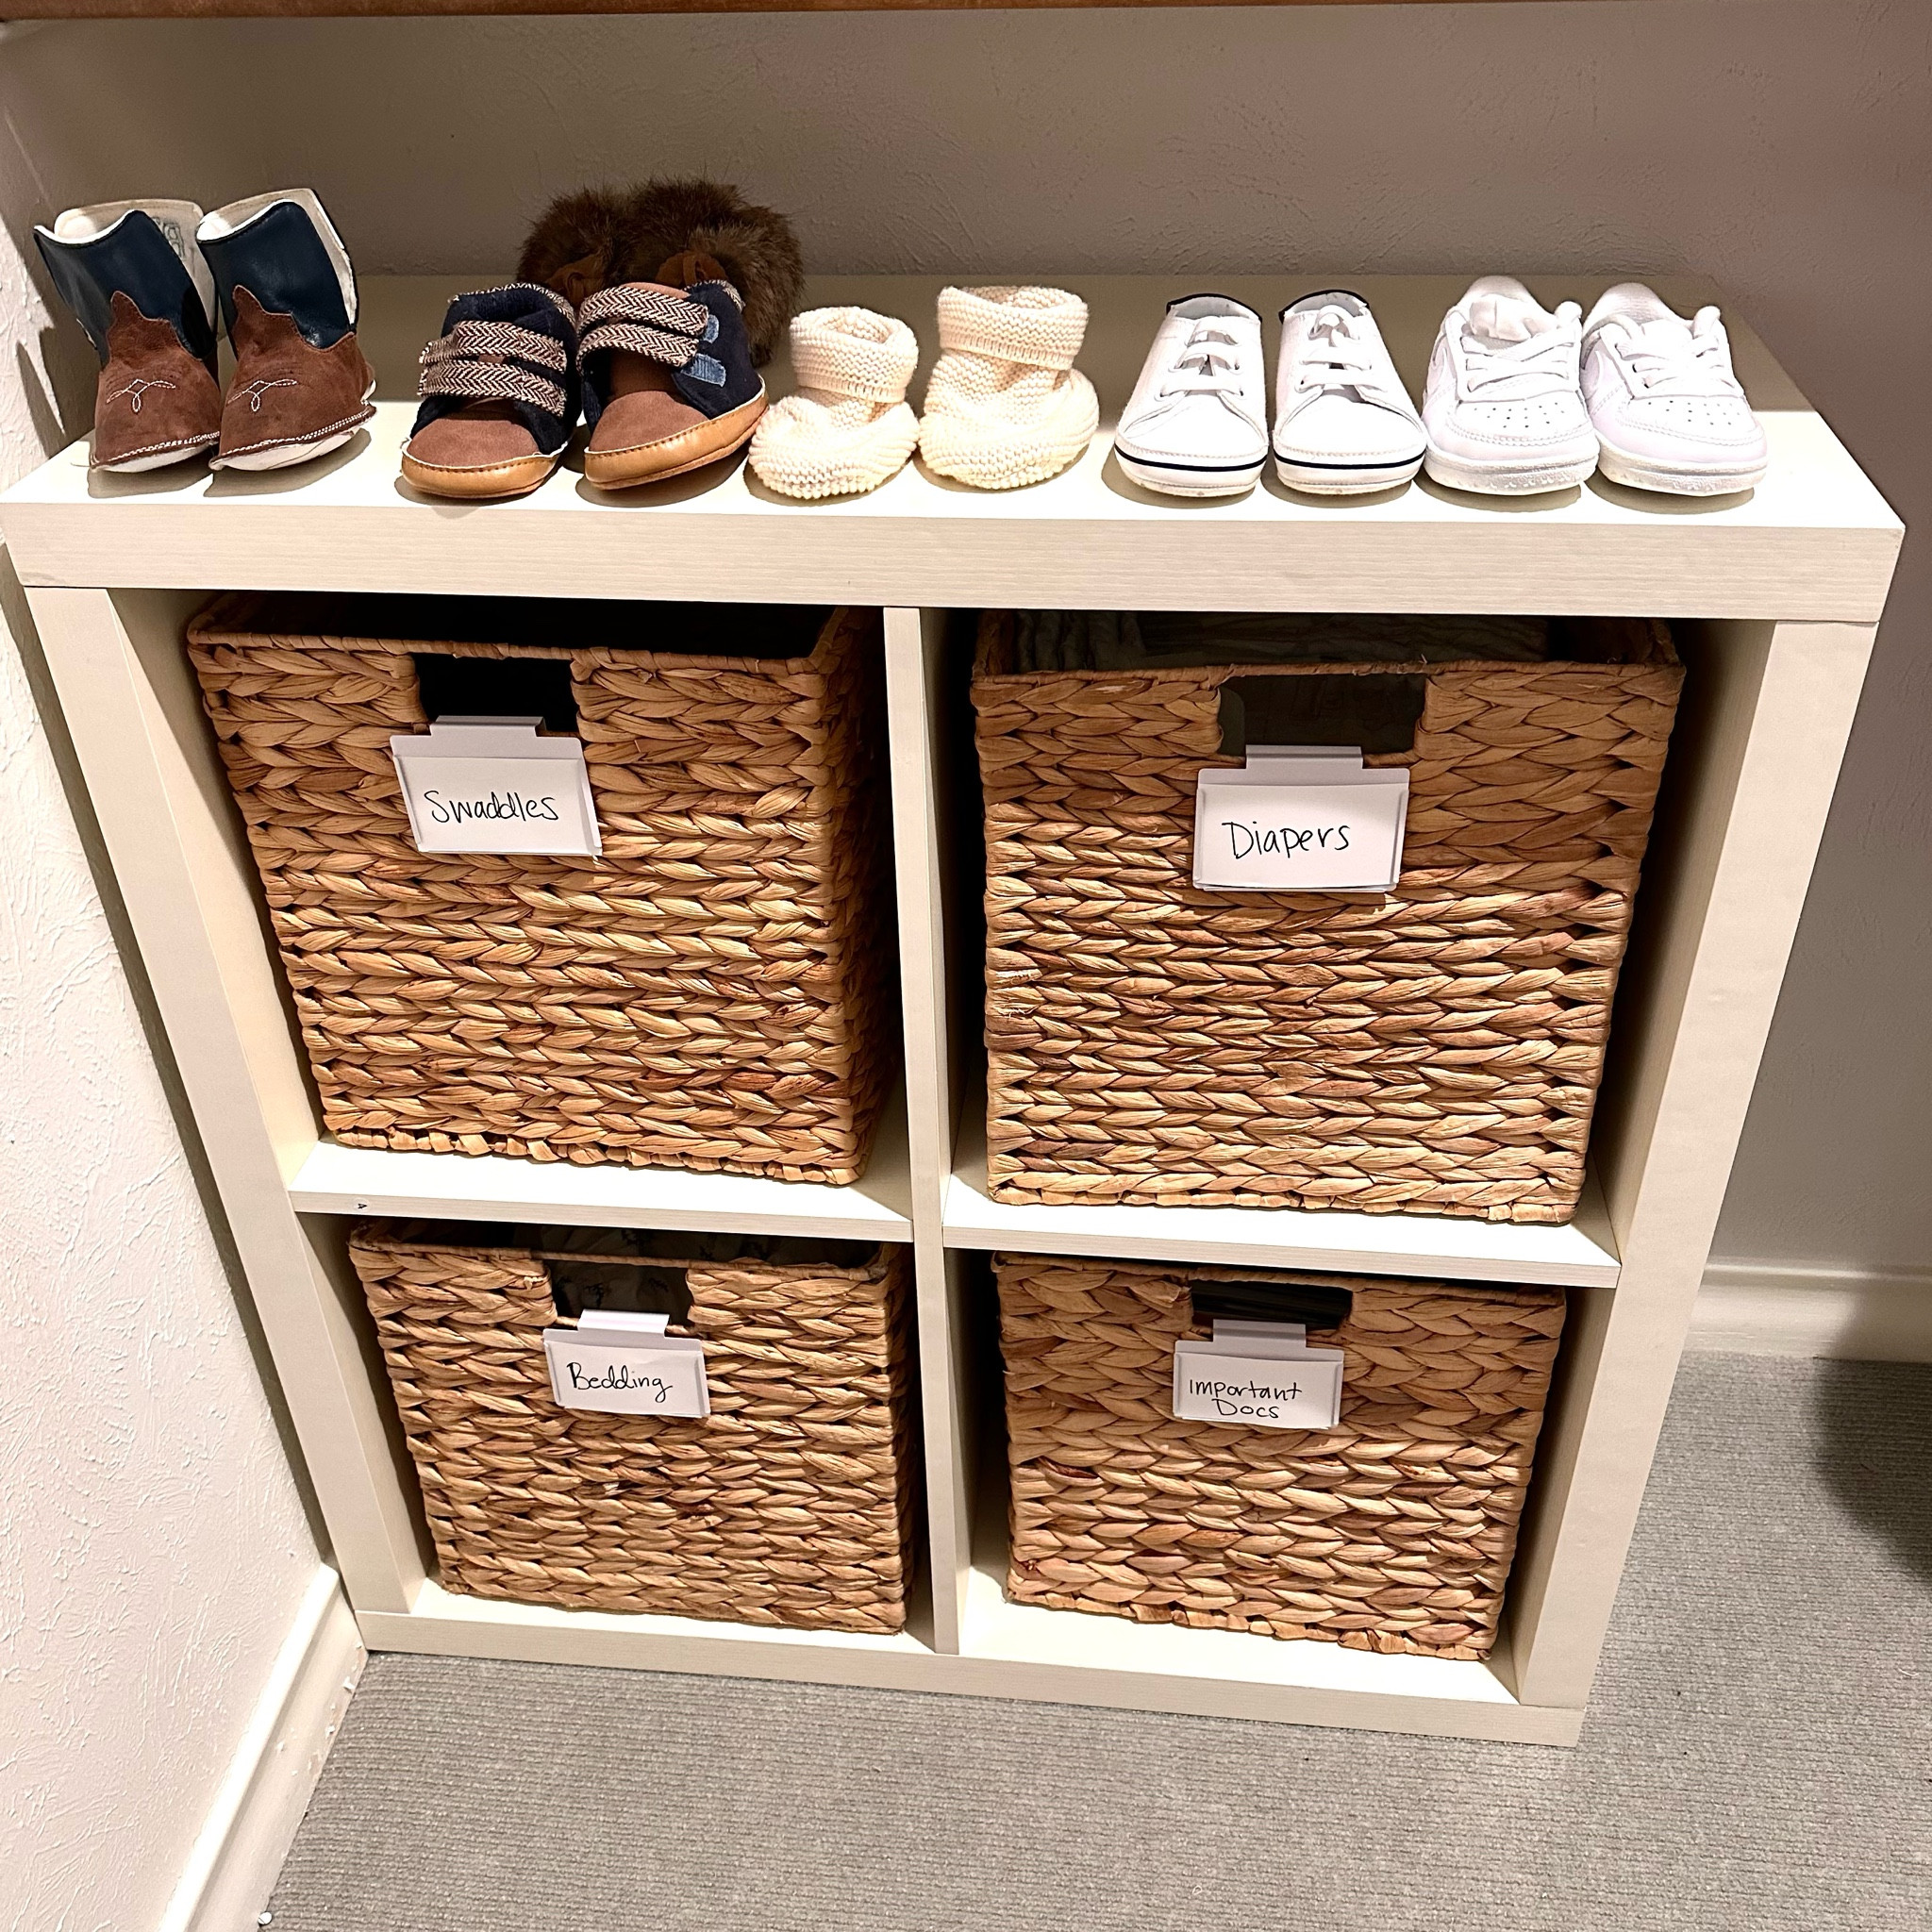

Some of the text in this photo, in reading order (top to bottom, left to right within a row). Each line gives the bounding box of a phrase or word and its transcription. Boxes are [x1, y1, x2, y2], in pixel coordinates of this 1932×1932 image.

[424, 790, 559, 824] Swaddles
[1221, 821, 1350, 859] Diapers
[566, 1361, 674, 1404] Bedding
[1189, 1378, 1303, 1402] Important
[1211, 1398, 1280, 1419] Docs
